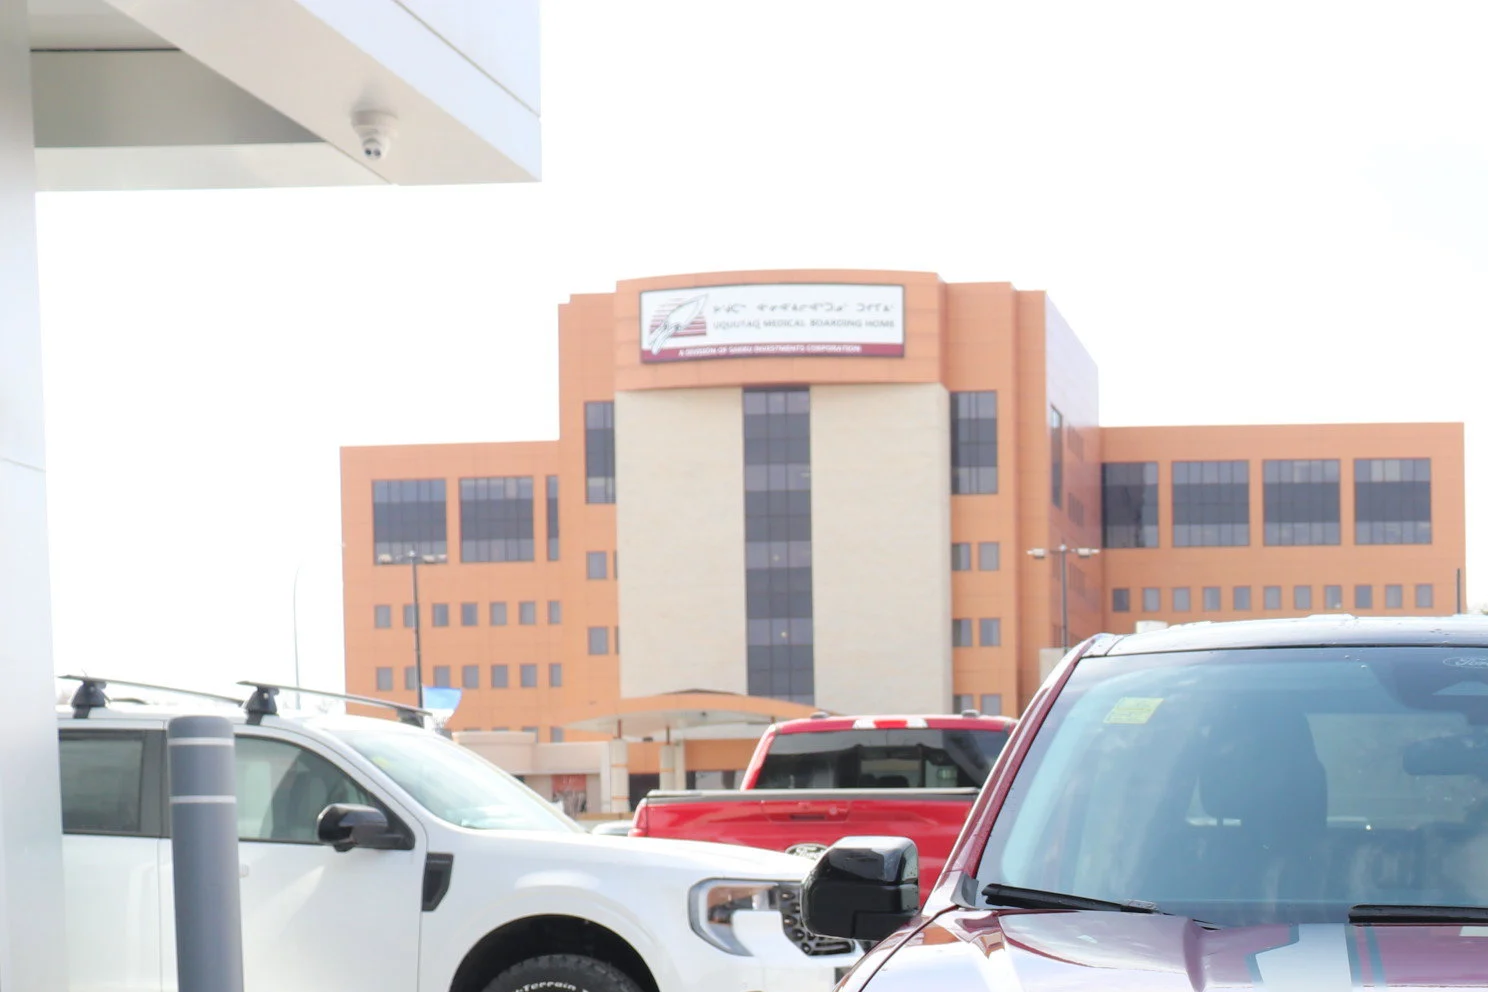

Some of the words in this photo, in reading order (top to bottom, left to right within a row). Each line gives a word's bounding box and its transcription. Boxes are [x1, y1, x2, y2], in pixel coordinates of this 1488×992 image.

[763, 318, 805, 328] MEDICAL
[809, 318, 863, 328] BOARDING
[865, 318, 895, 328] HOME
